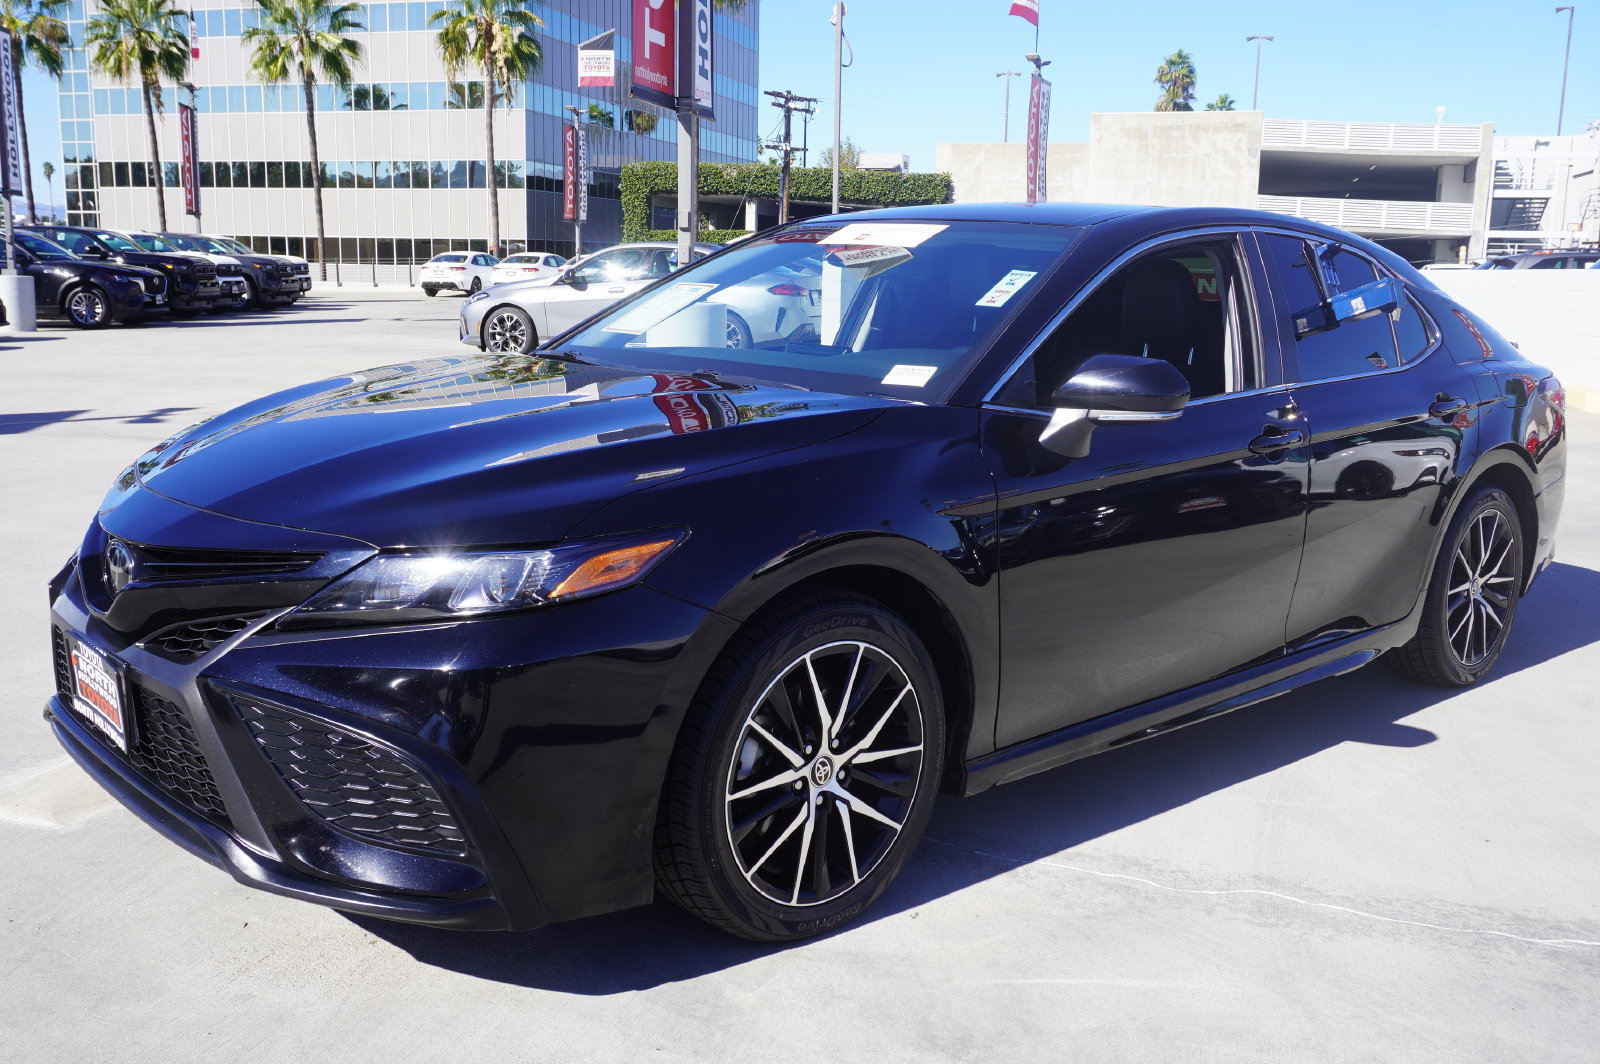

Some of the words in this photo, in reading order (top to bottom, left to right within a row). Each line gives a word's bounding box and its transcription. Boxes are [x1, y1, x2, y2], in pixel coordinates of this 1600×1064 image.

[2, 38, 19, 178] HOLLYWOOD
[182, 109, 193, 204] TOYOTA
[1028, 84, 1039, 194] TOYOTA
[566, 130, 574, 212] TOYOTA
[804, 614, 868, 638] GeoDrive
[78, 641, 104, 672] TOYOTA
[79, 657, 116, 698] NORTH
[78, 670, 117, 709] HOLLYWOOD
[80, 680, 122, 728] TOYOTA
[74, 698, 94, 722] NORTH
[94, 712, 126, 753] HOLLYWOOD
